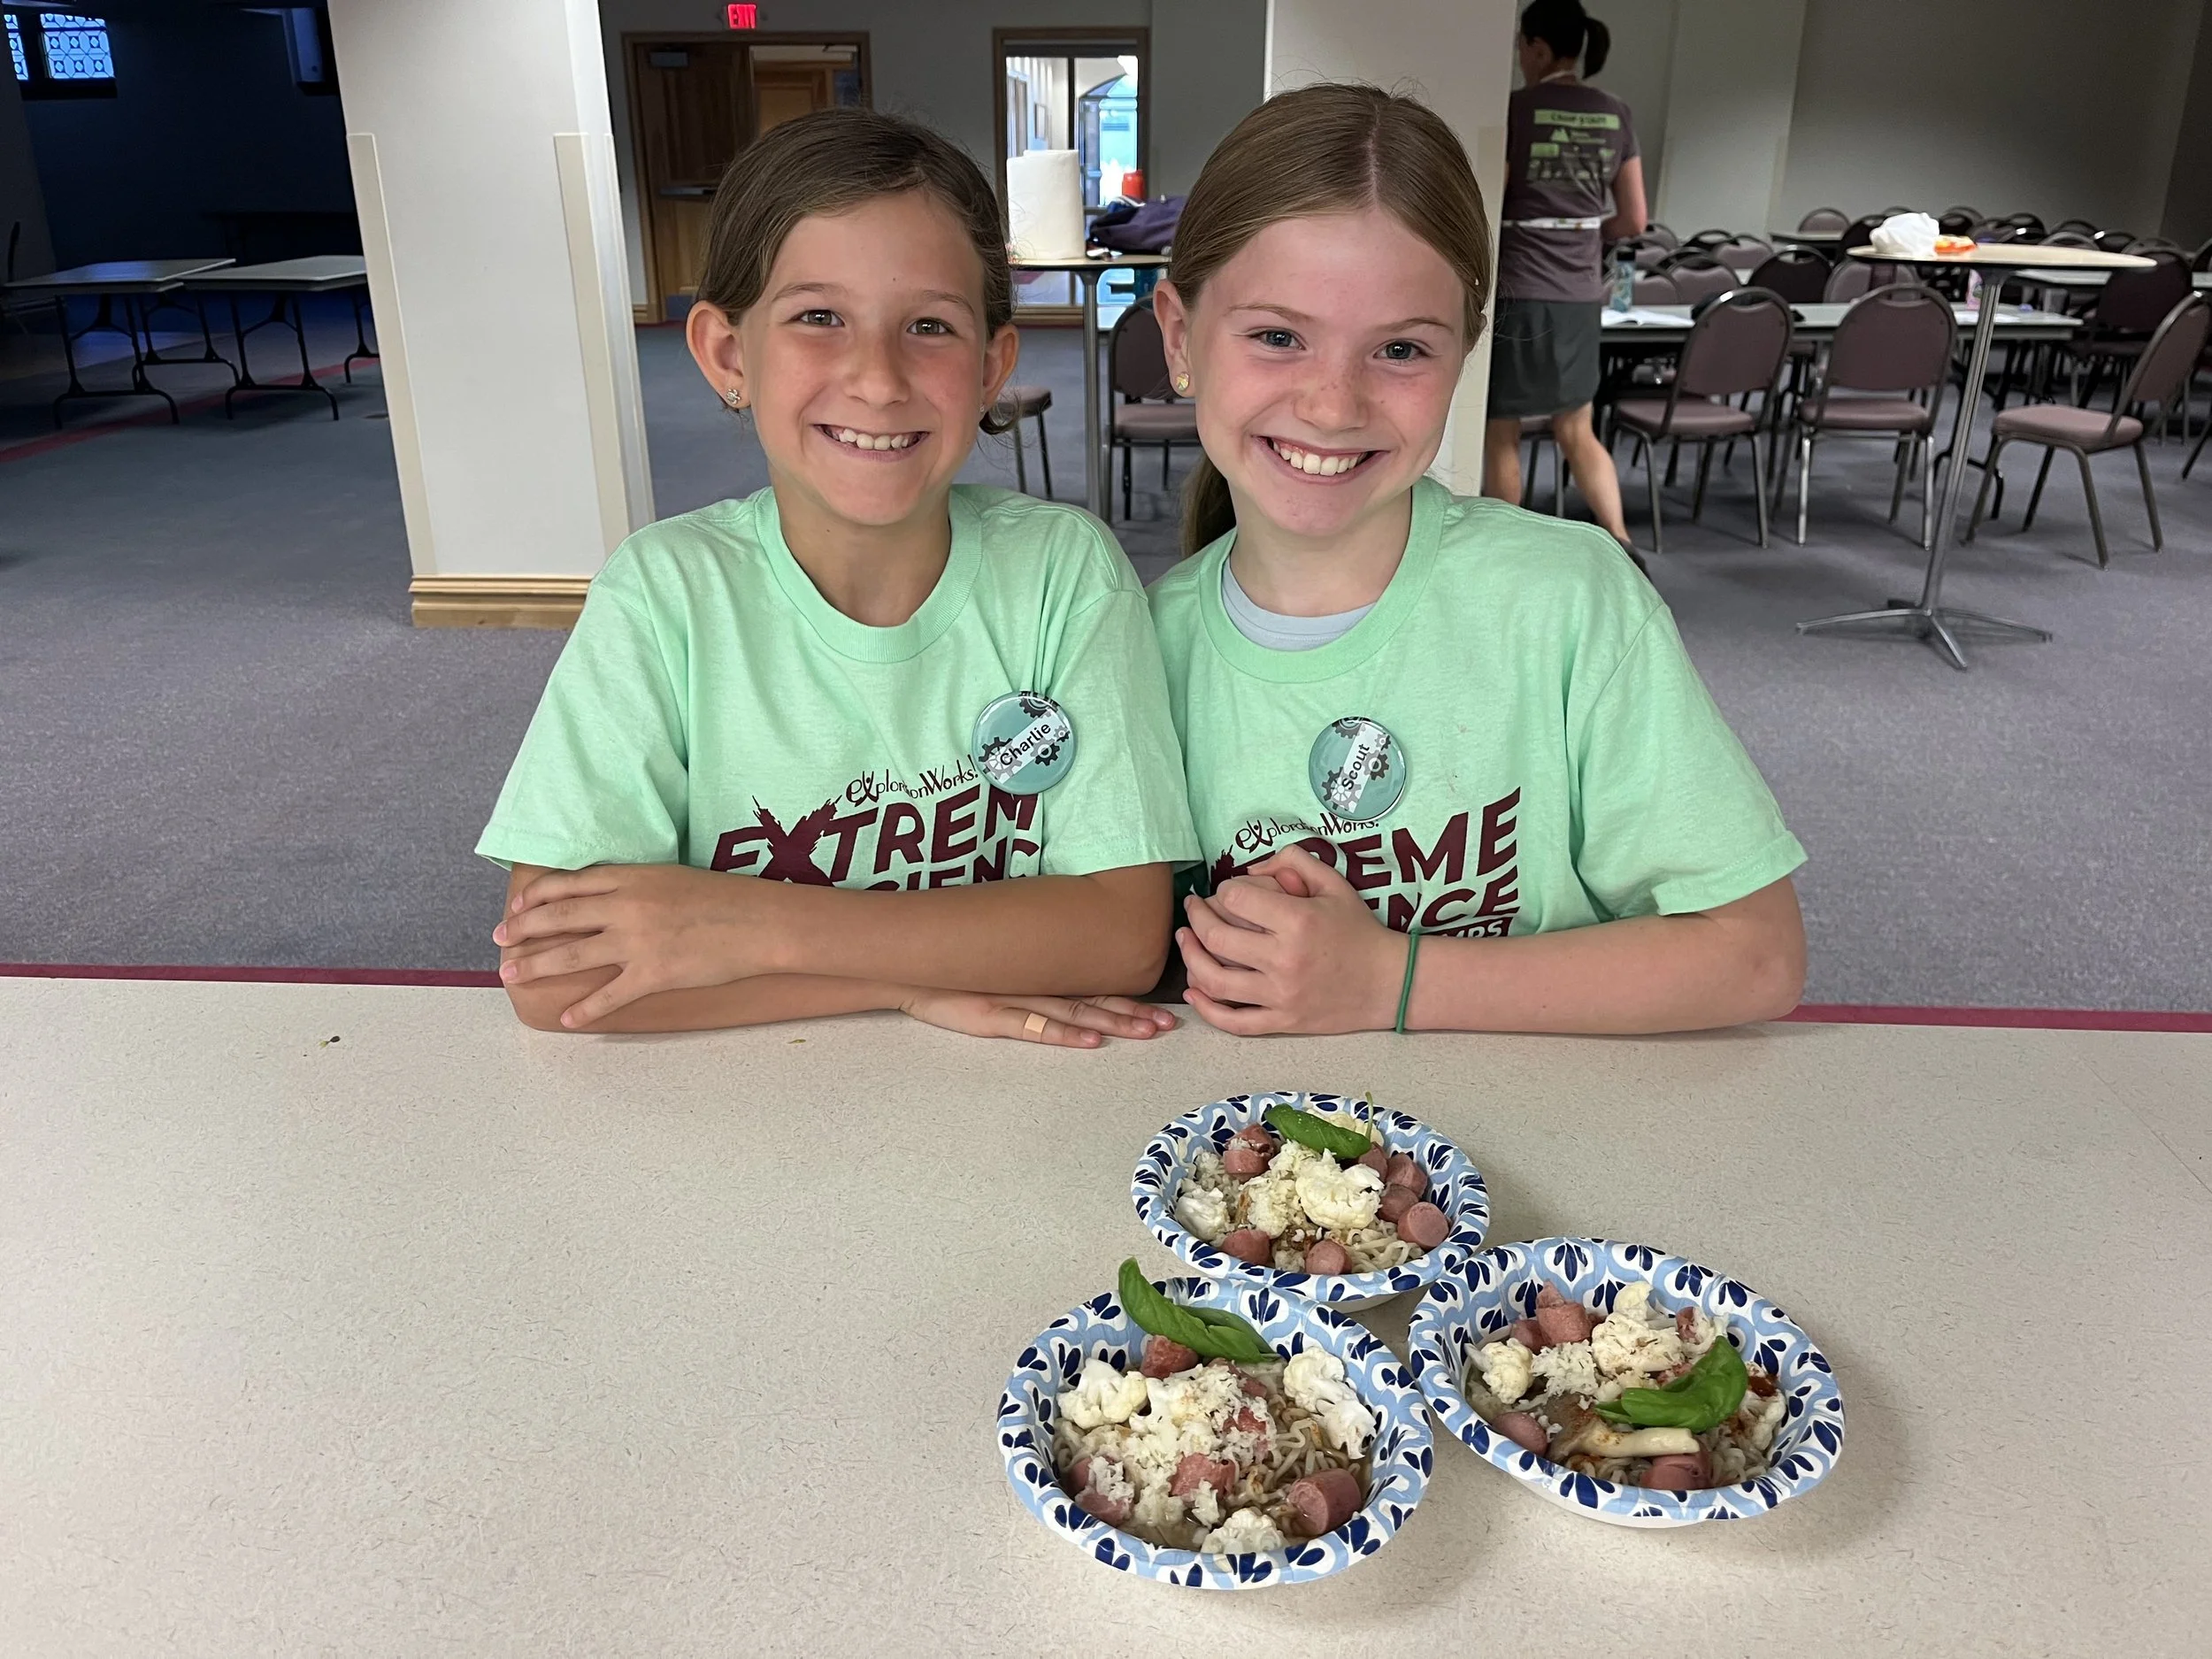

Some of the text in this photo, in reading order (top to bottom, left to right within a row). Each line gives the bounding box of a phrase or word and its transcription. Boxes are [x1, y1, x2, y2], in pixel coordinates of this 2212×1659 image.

[728, 4, 757, 29] EXIT
[1000, 724, 1051, 765] Charlie
[1341, 743, 1370, 790] Scout
[710, 784, 1039, 887] EXTREM
